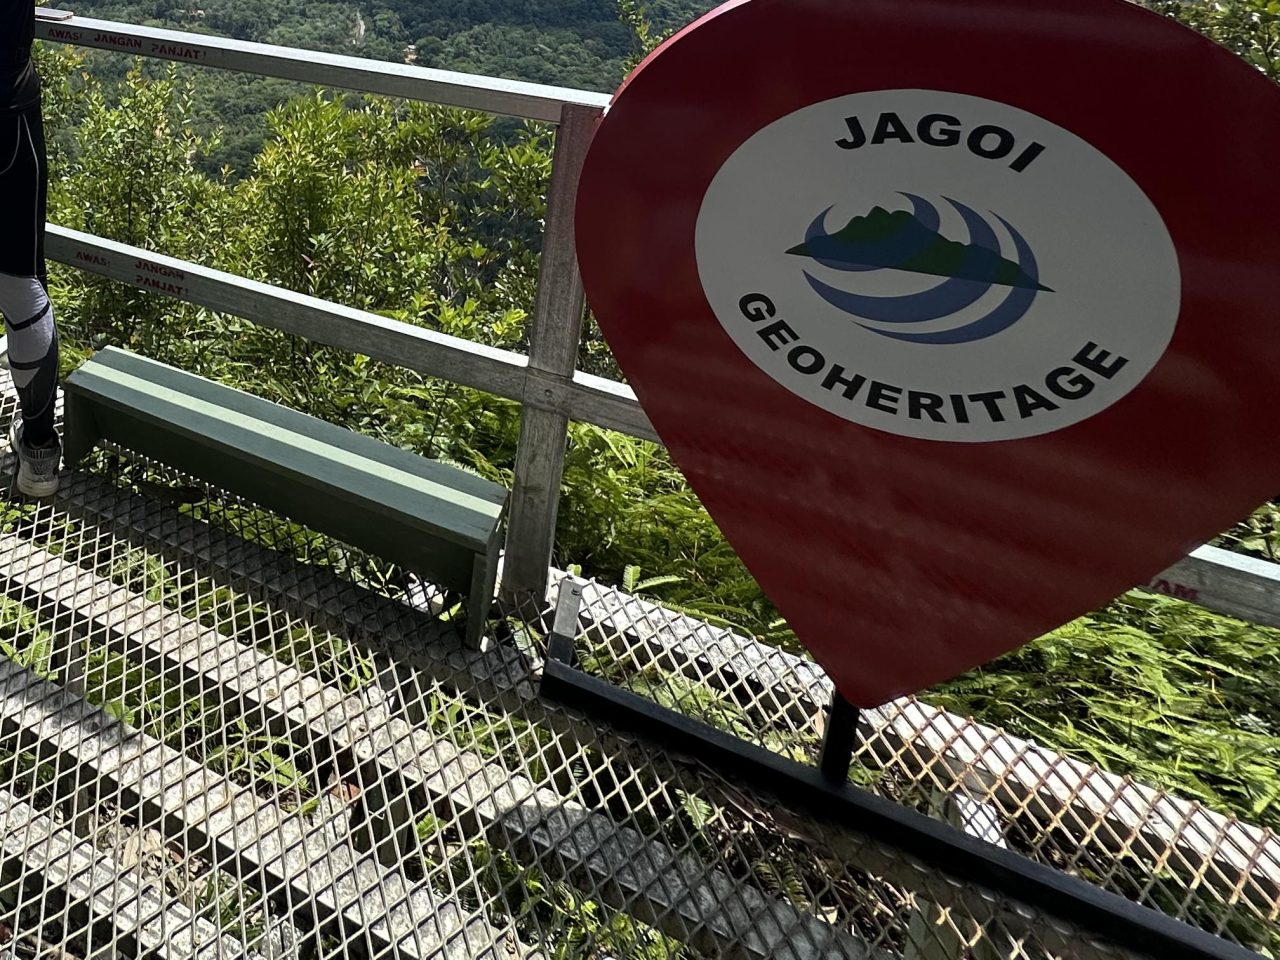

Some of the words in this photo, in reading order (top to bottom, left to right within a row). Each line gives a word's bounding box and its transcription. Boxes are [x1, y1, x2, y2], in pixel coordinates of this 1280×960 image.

[48, 28, 82, 41] AWAS!
[94, 34, 142, 49] JANGAN
[834, 112, 1046, 173] JAGOI
[135, 261, 185, 280] JANGAN
[738, 292, 1129, 423] GEOHERITAGE
